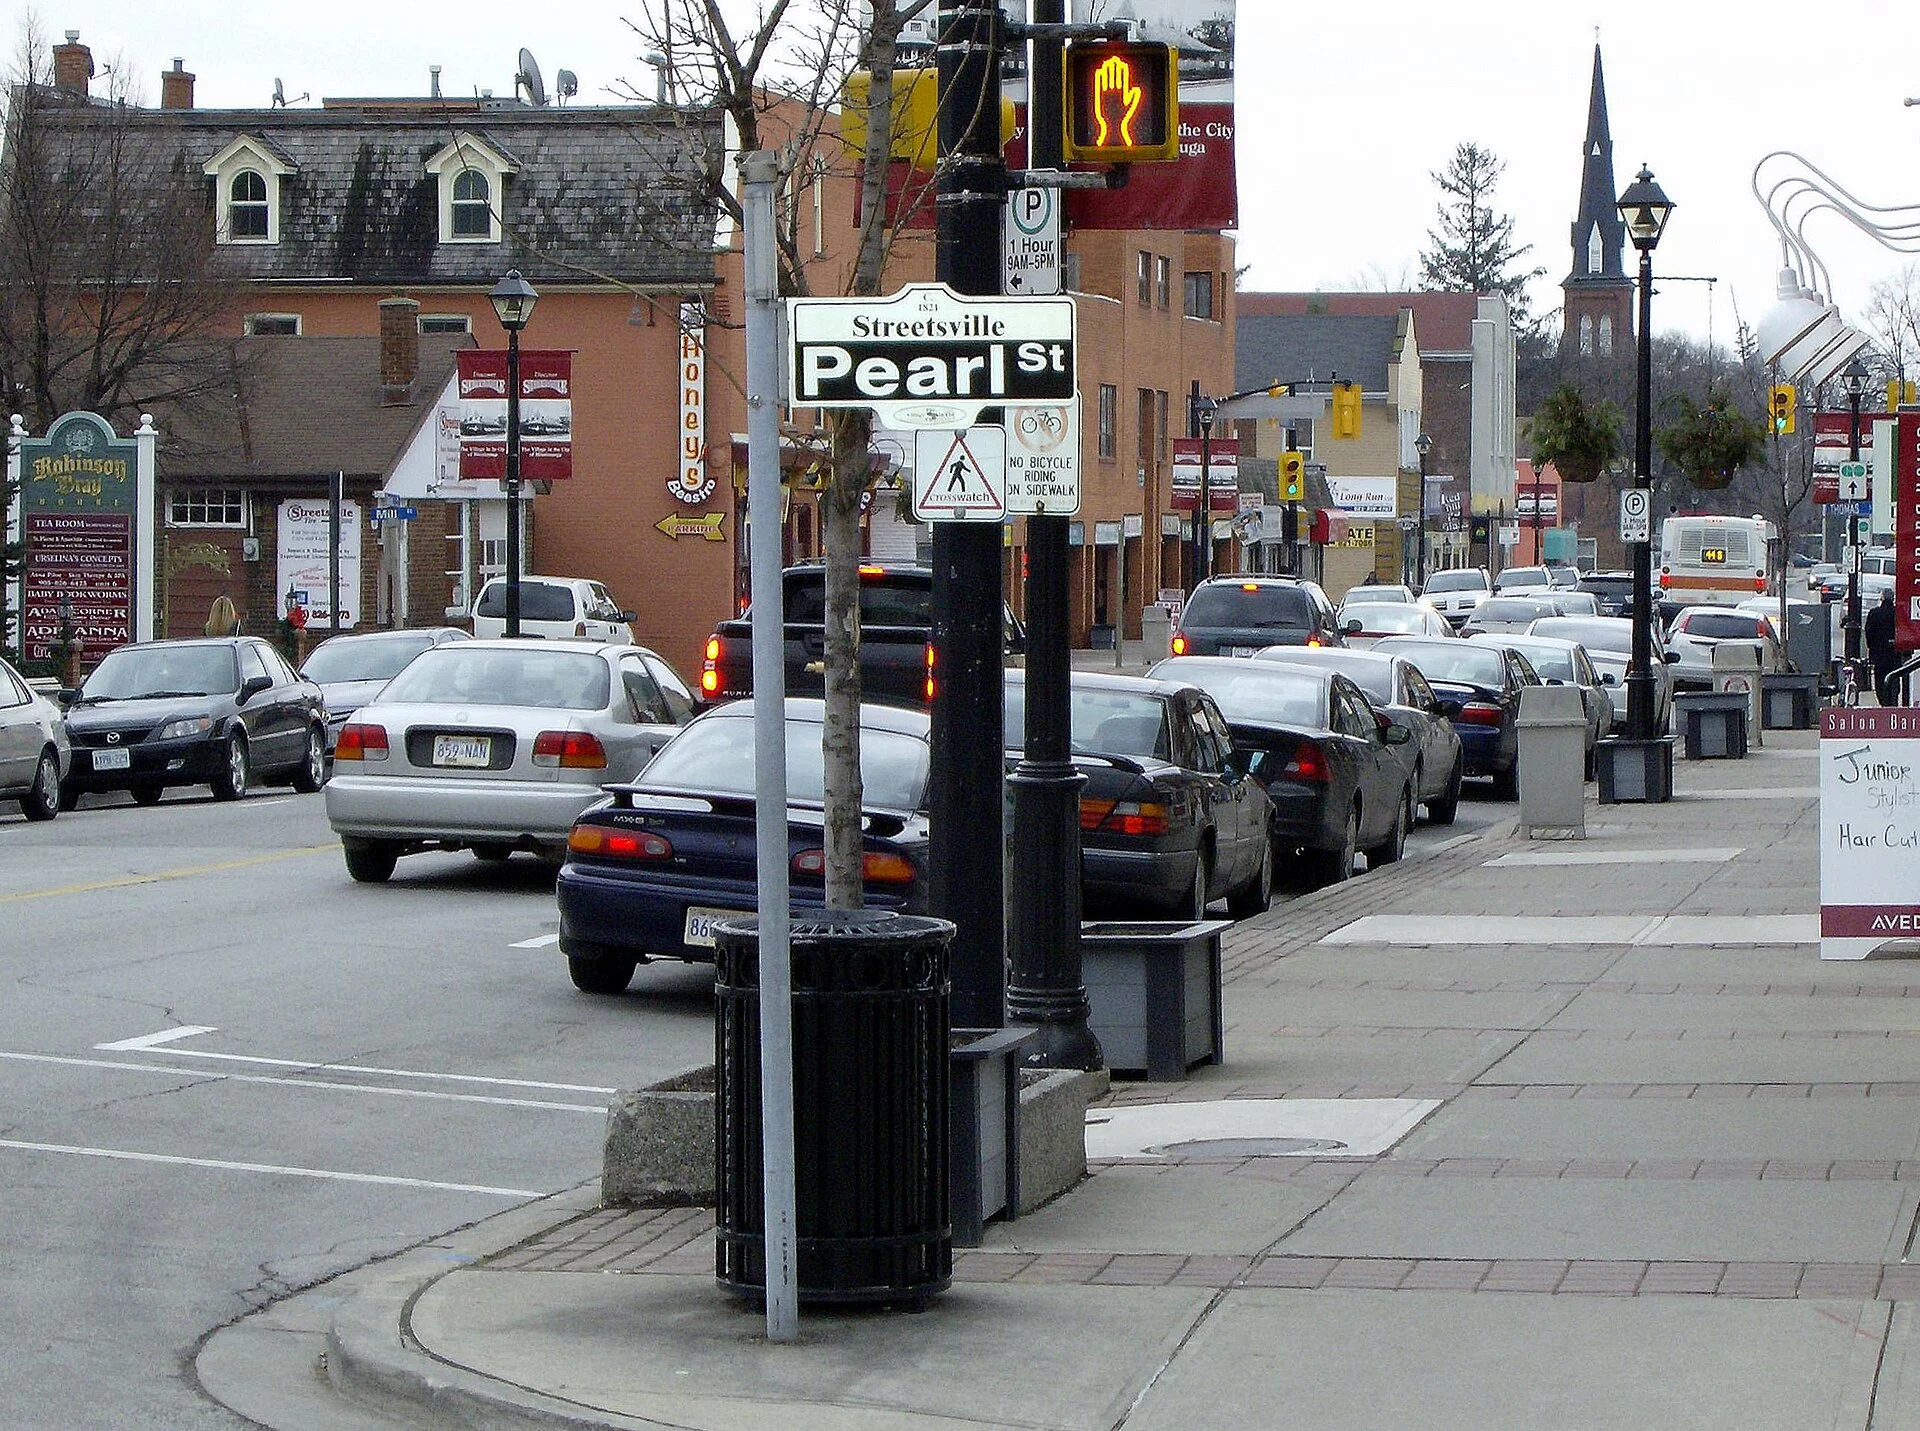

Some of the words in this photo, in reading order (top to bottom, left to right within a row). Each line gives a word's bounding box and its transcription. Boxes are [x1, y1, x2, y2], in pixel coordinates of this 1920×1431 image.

[1178, 122, 1200, 137] the
[1206, 122, 1234, 140] City
[1010, 239, 1016, 254] 1
[1022, 238, 1054, 253] Hour
[1007, 253, 1056, 270] 9AM-5PM
[918, 303, 939, 312] 1821
[852, 314, 1006, 338] Streetsville
[802, 344, 1005, 397] Pearl
[1017, 342, 1065, 372] St
[1010, 457, 1023, 468] NO
[1029, 457, 1072, 468] BICYCLE
[1024, 470, 1056, 482] RIDING
[1026, 484, 1075, 496] SIDEWALK
[1339, 492, 1363, 502] Long
[1365, 492, 1384, 501] Run
[35, 519, 53, 528] TEA
[55, 519, 85, 528] ROOM
[1828, 713, 1876, 731] Salon
[1889, 713, 1917, 731] Bar
[1838, 823, 1877, 849] Hair
